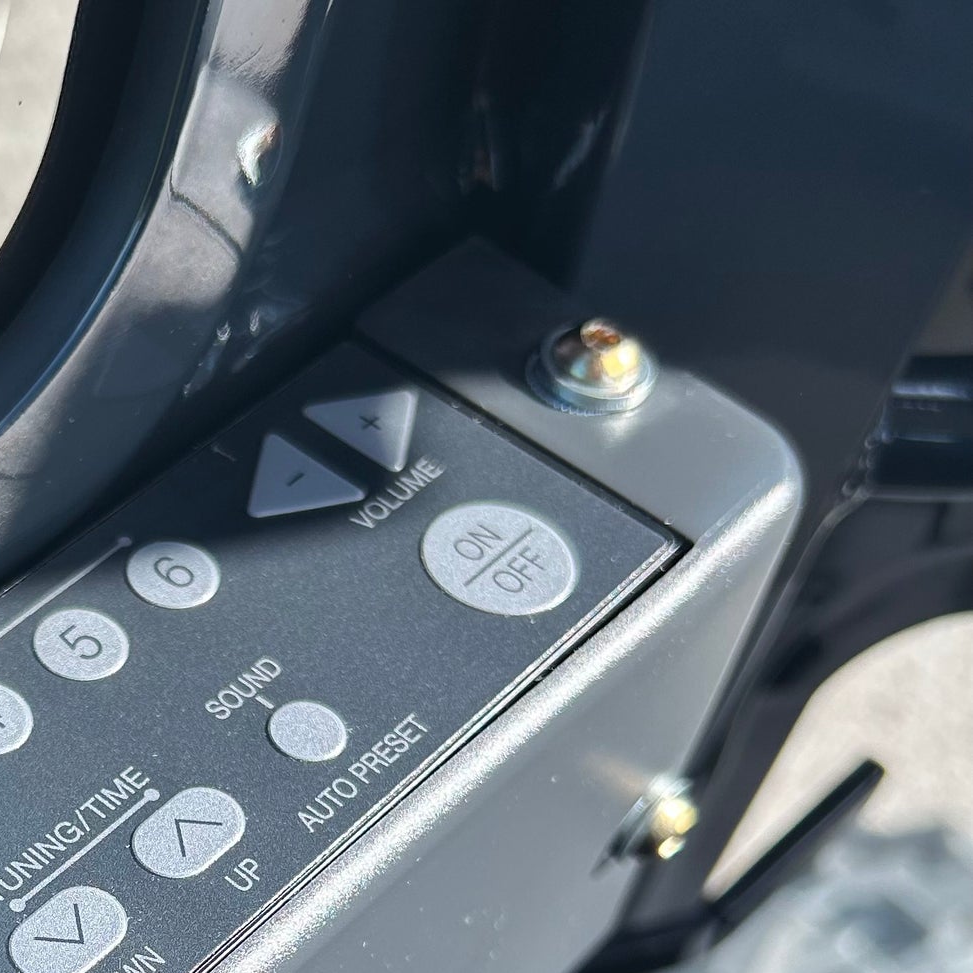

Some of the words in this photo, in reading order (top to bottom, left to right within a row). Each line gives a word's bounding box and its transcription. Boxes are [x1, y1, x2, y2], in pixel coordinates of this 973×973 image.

[349, 456, 444, 530] VOLUME
[453, 524, 502, 562] ON
[153, 555, 194, 588] 6
[493, 545, 546, 594] OFF
[59, 623, 103, 661] 5
[204, 656, 283, 721] SOUND
[296, 776, 359, 834] AUTO
[348, 712, 429, 786] PRESET
[224, 857, 262, 893] UP
